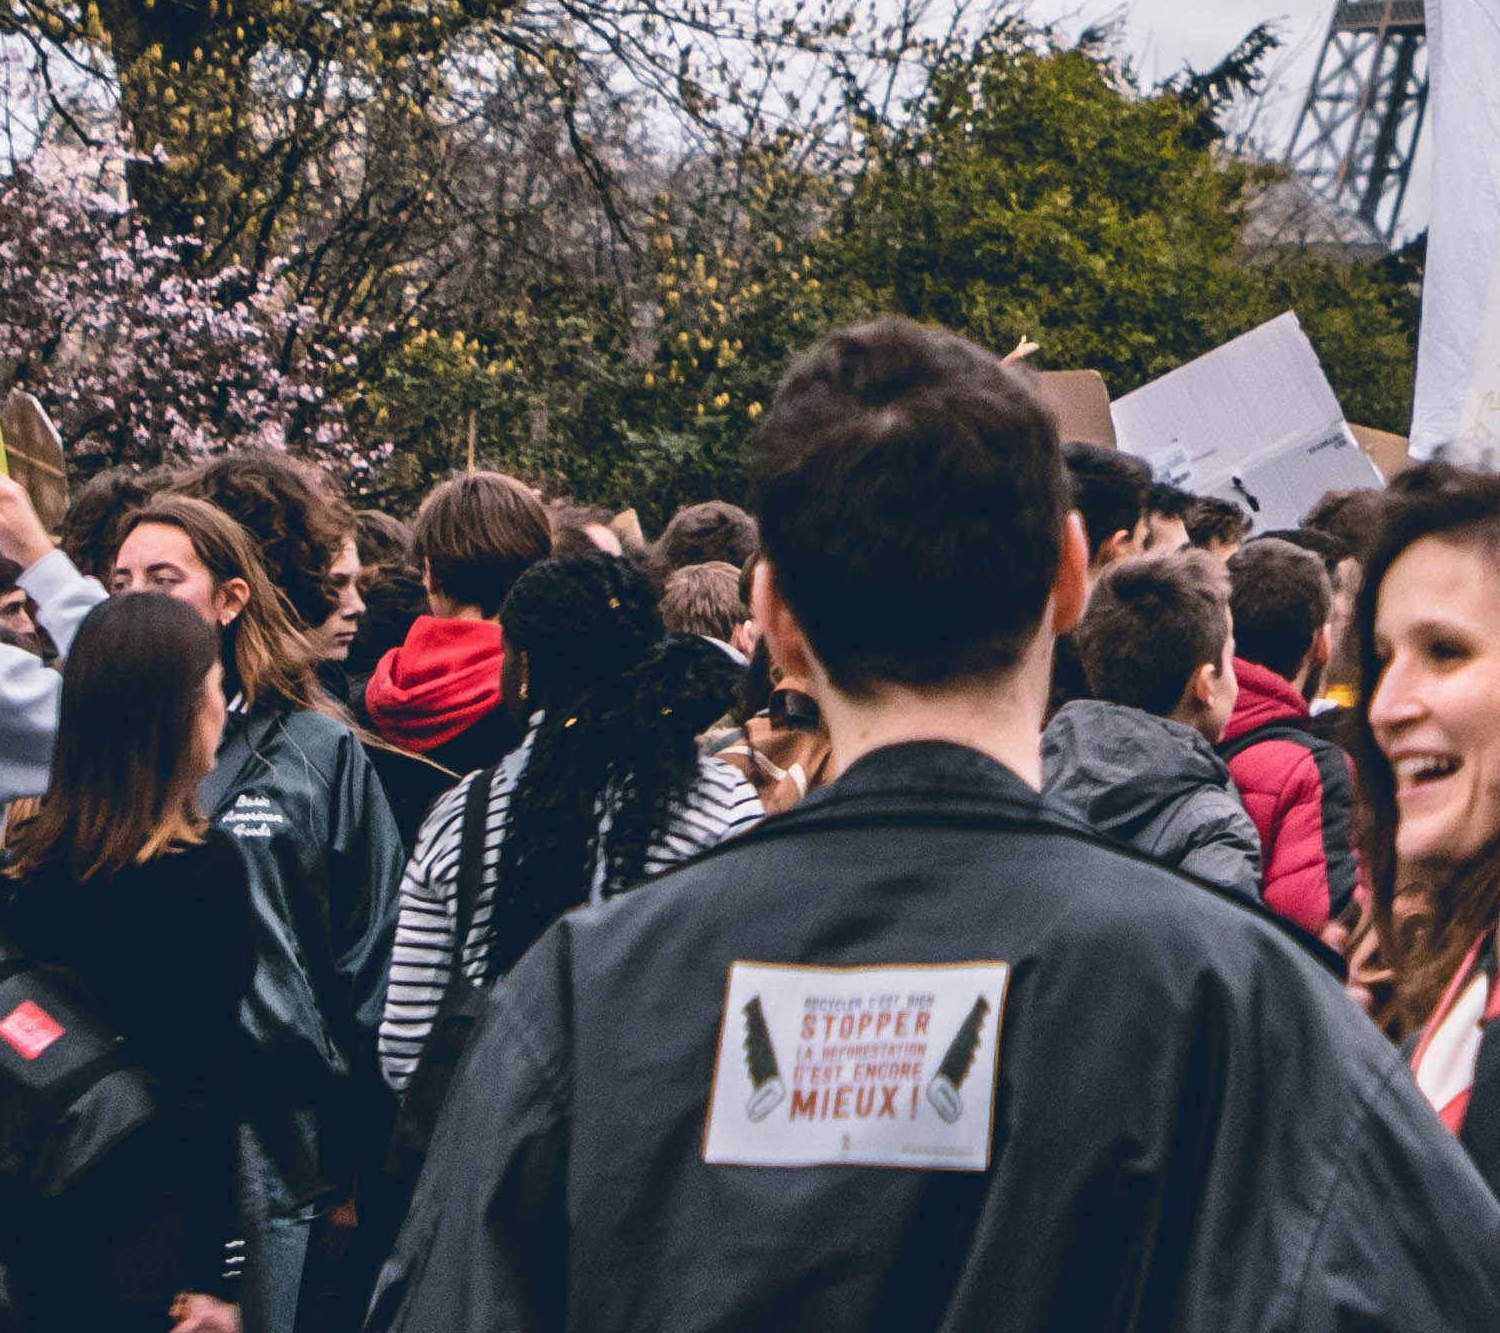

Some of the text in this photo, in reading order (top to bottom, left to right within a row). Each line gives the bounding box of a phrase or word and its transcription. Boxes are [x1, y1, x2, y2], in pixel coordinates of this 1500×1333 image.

[800, 1010, 931, 1041] STOPPER
[853, 1061, 924, 1082] ENCORE
[789, 1084, 900, 1122] MIEUX
